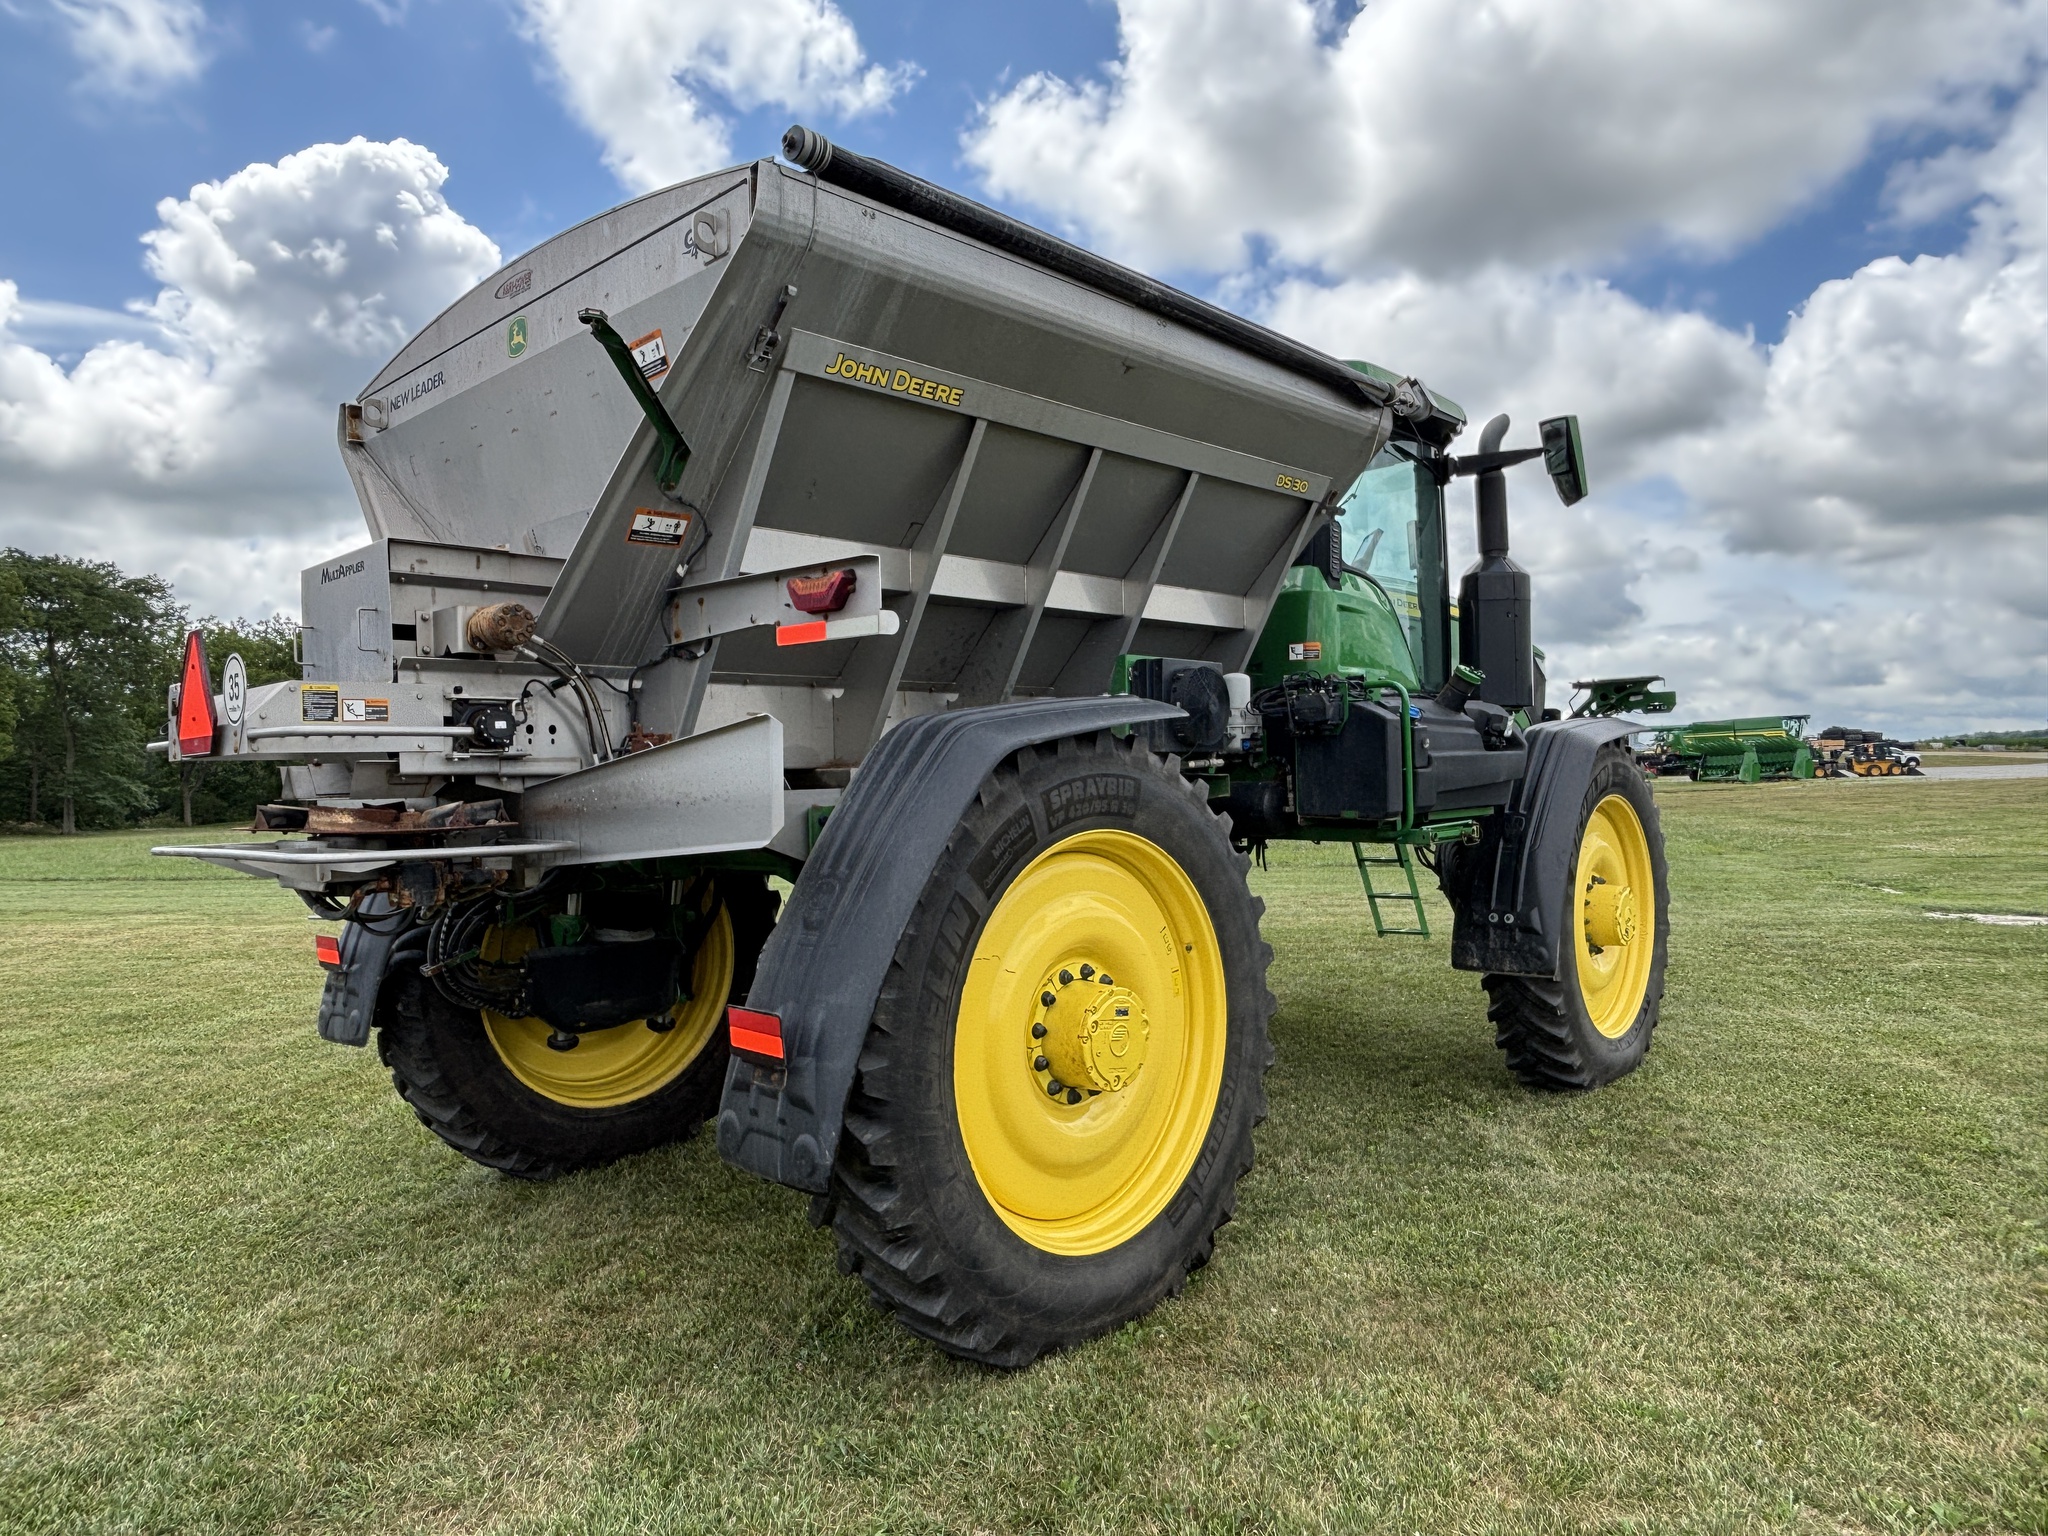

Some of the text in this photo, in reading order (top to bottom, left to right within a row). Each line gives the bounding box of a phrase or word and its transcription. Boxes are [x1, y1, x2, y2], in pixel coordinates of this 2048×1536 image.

[389, 370, 444, 413] NEW LEADER
[825, 352, 965, 407] JOHN DEERE
[1396, 598, 1418, 610] DEER
[228, 672, 240, 702] 35
[1049, 776, 1135, 811] SPRAYBIB
